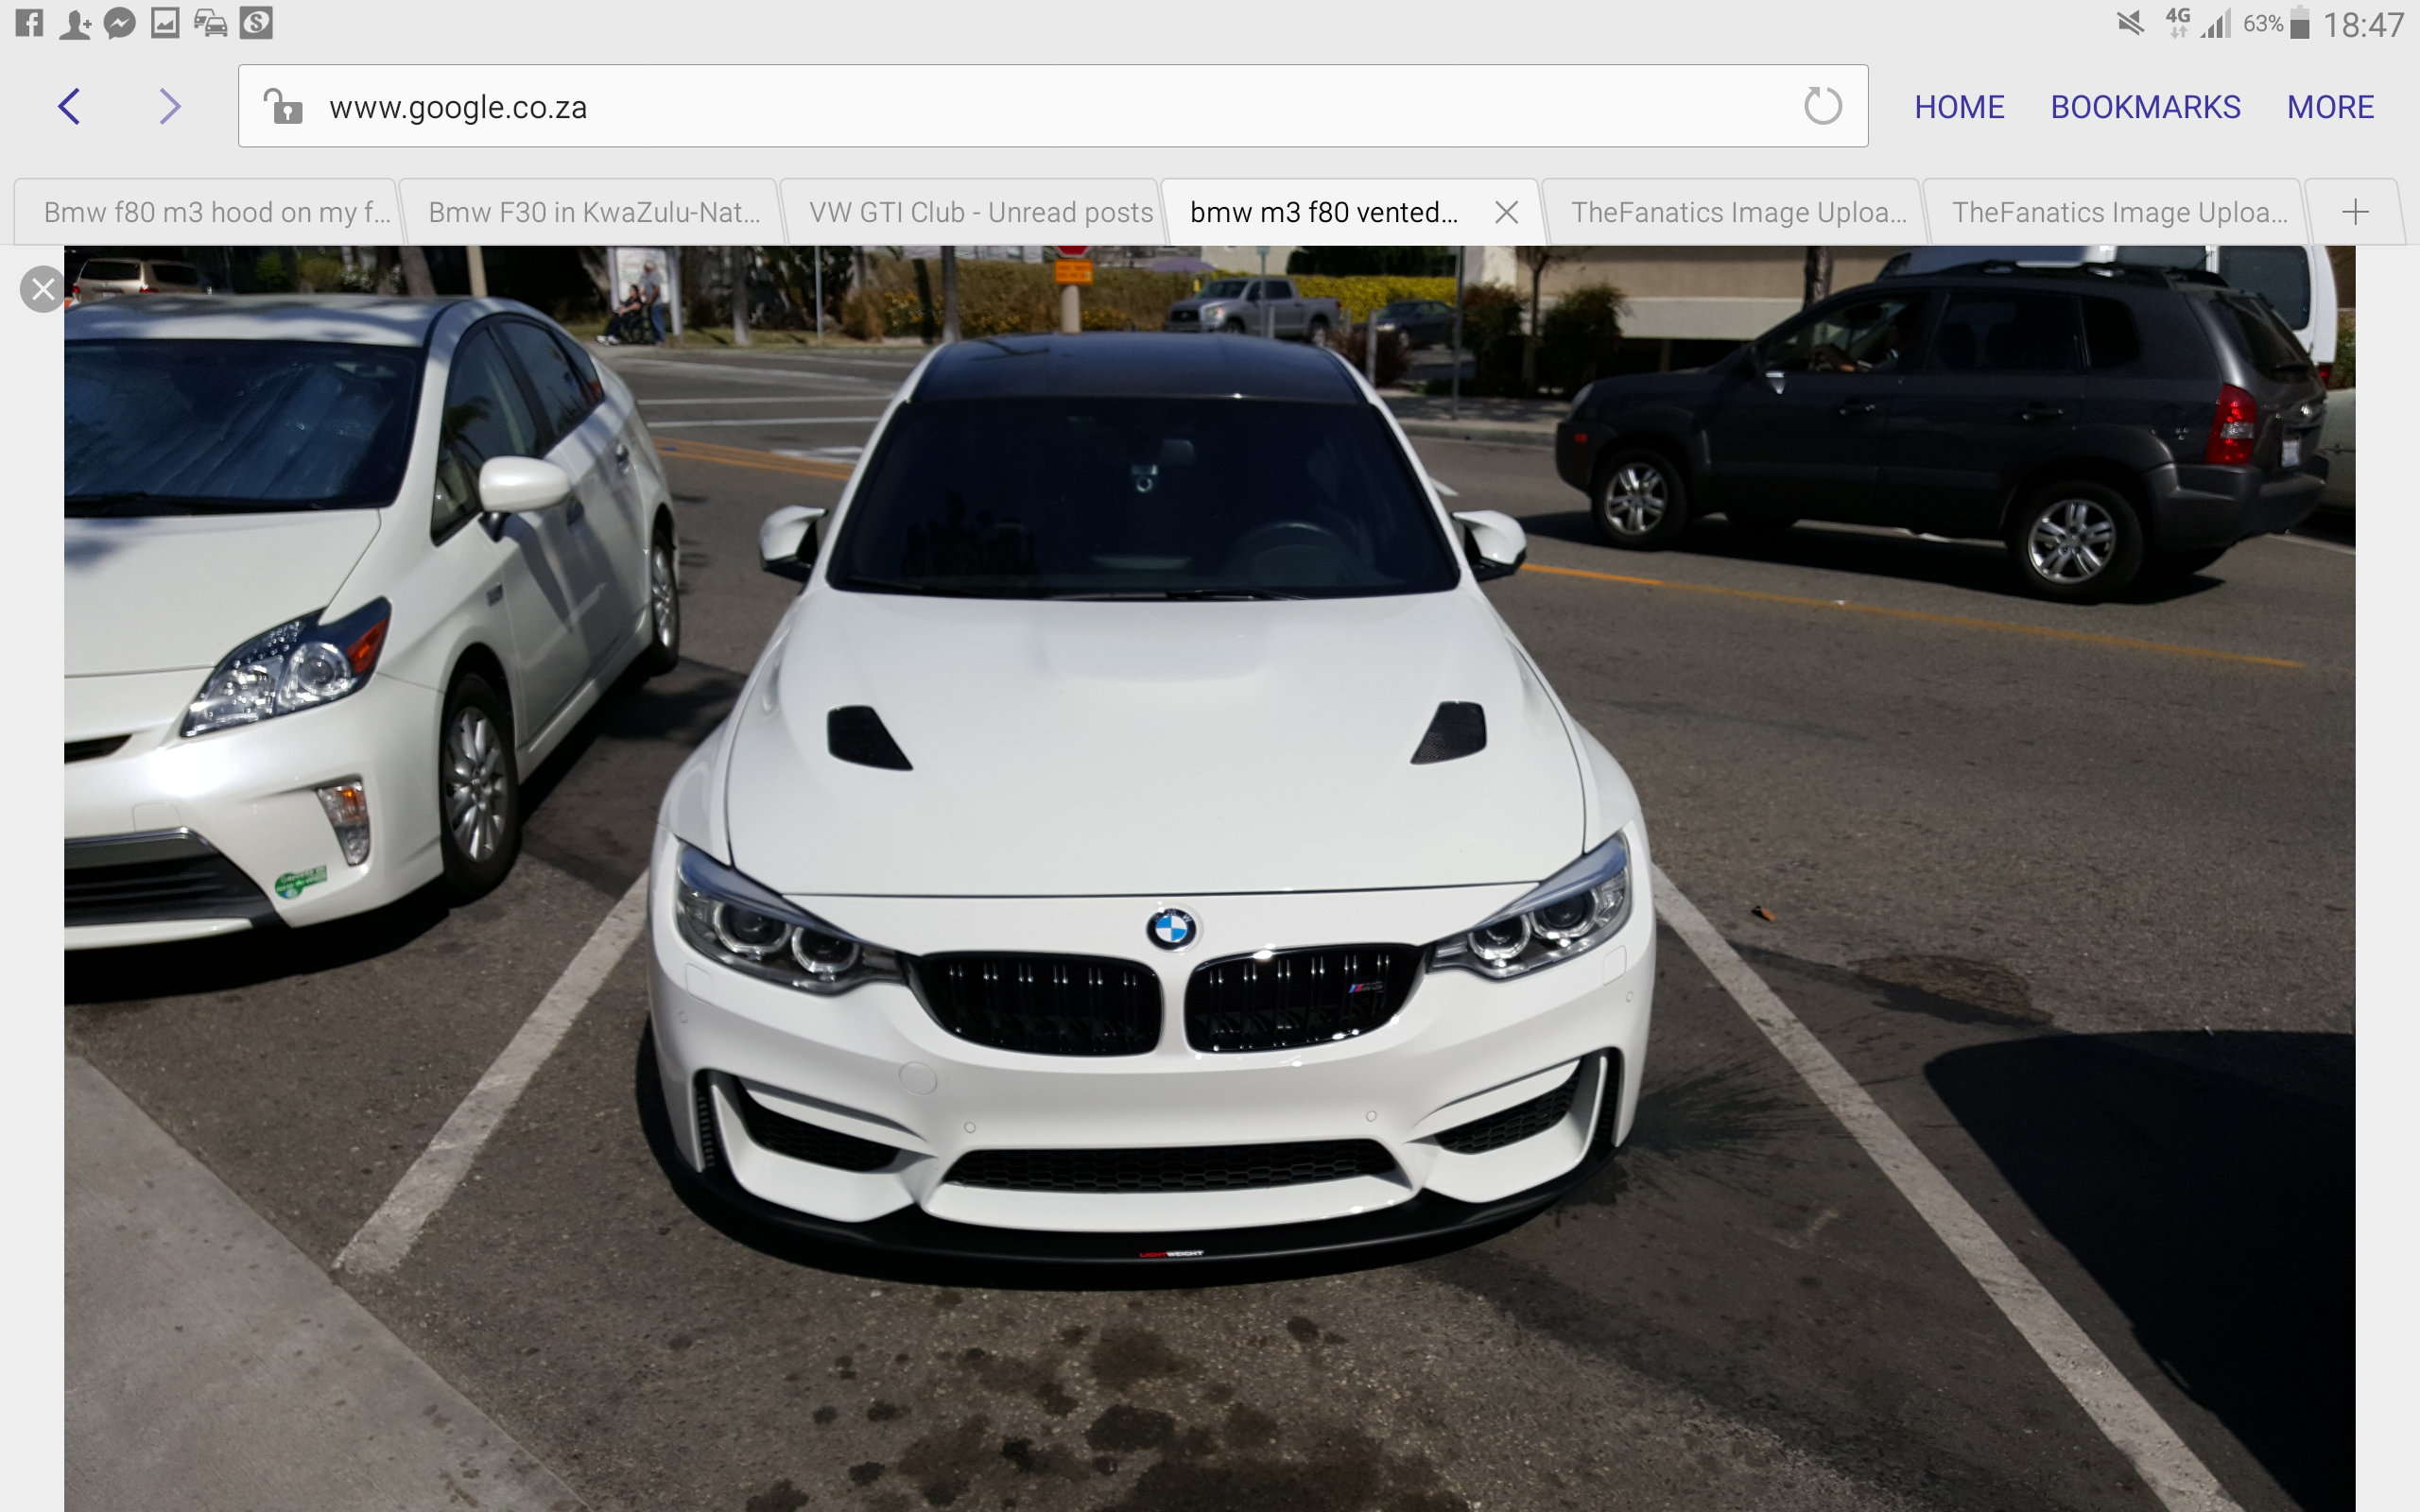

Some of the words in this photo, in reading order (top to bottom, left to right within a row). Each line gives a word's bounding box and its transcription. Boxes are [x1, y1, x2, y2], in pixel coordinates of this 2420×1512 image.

[2165, 7, 2191, 24] 4G
[2243, 13, 2285, 33] 63%
[2325, 11, 2406, 39] 18:47
[329, 93, 587, 126] www.google.co.za
[1916, 94, 2005, 120] HOME
[2052, 94, 2241, 120] BOOKMARKS
[2289, 94, 2375, 120] MORE
[45, 201, 107, 223] Bmw
[114, 199, 155, 223] f80
[164, 200, 203, 223] m3
[212, 199, 272, 223] hood
[281, 206, 311, 223] on
[320, 206, 358, 229] my
[430, 201, 492, 223] Bmw
[501, 200, 546, 223] F30
[555, 200, 575, 223] in
[584, 199, 760, 223] KwaZulu-Nat...
[809, 201, 853, 223] VW
[860, 200, 902, 223] GTI
[911, 199, 965, 223] Club
[989, 199, 1076, 223] Unread
[1085, 202, 1154, 229] posts
[1191, 199, 1253, 224] bmw
[1261, 200, 1301, 224] m3
[1307, 199, 1350, 224] f80
[1356, 199, 1458, 224] vented...
[1571, 199, 1724, 223] TheFanatics
[1733, 201, 1810, 229] Image
[1818, 199, 1907, 229] Uploa...
[1952, 199, 2105, 223] TheFanatics
[2114, 201, 2191, 229] Image
[2199, 199, 2288, 229] Uploa...
